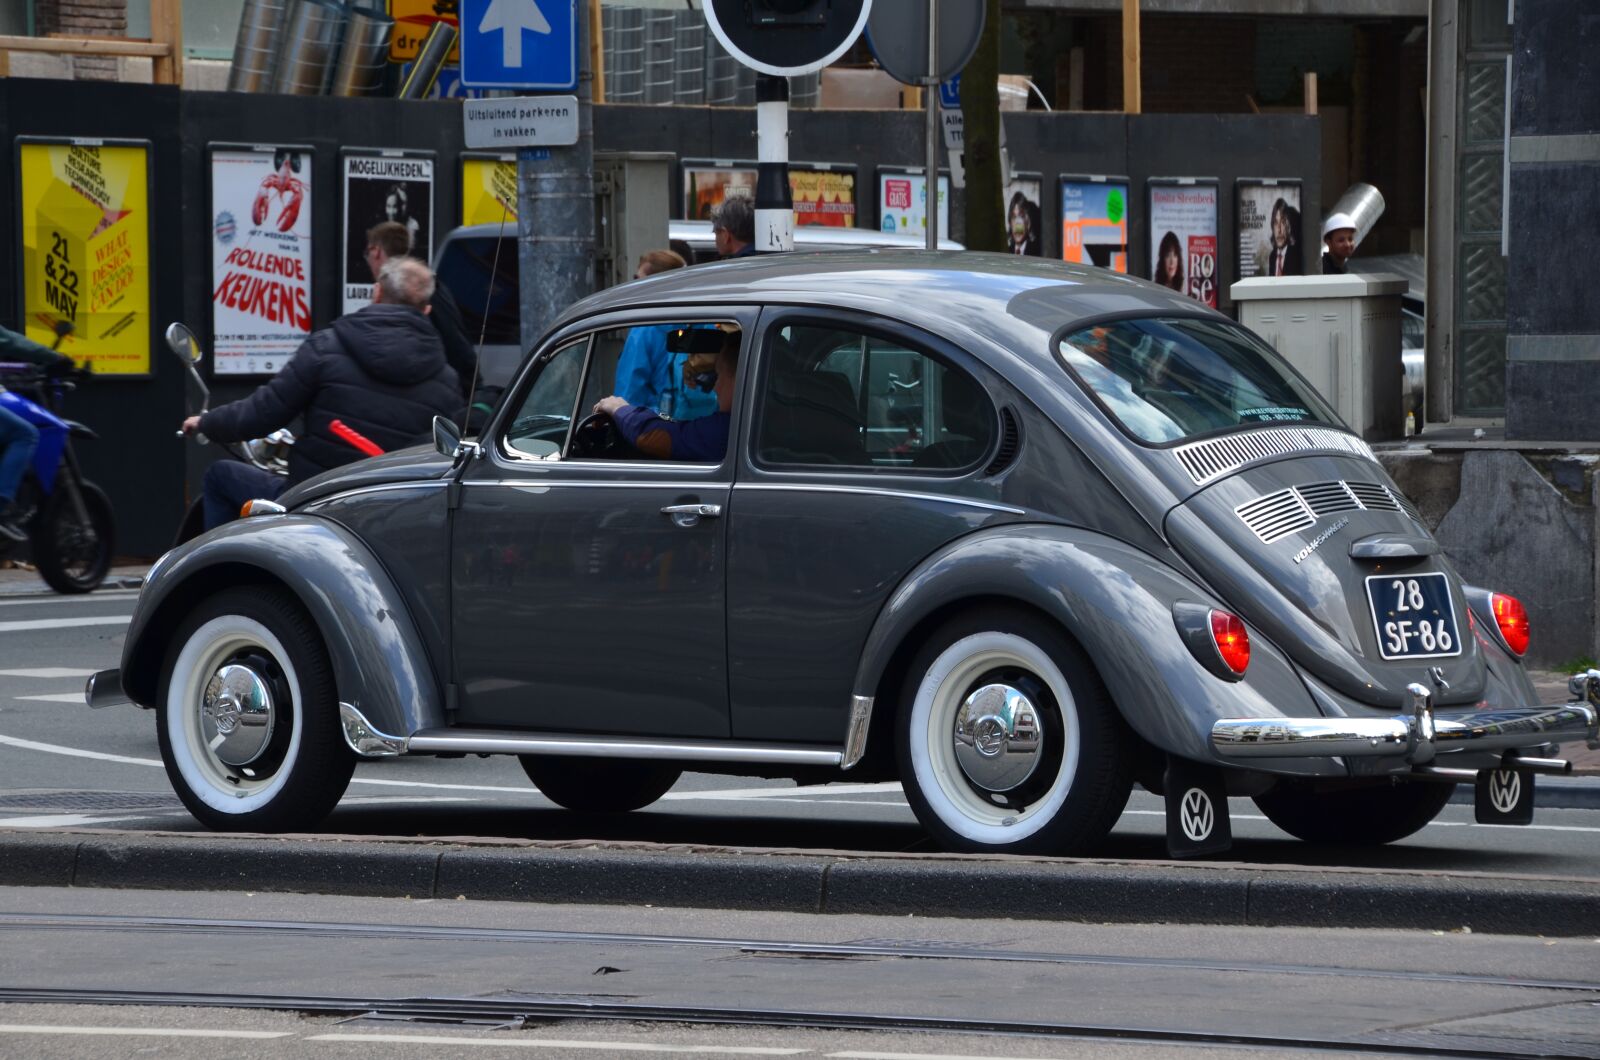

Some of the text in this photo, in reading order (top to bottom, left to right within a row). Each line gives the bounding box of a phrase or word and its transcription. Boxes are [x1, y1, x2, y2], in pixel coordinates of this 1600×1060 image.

[468, 106, 569, 121] Uitsluitend parkeren
[945, 115, 963, 126] Alle
[493, 126, 537, 138] in vakken
[64, 163, 111, 205] TECHNOLOGY
[67, 154, 106, 189] RESEARCH
[889, 191, 907, 207] GRATIS
[52, 231, 70, 263] 21
[95, 230, 128, 263] WHAT
[45, 253, 79, 297] & 22
[93, 246, 132, 286] DESIGN
[225, 247, 305, 281] ROLLENDE
[45, 279, 78, 322] MAY
[211, 271, 312, 332] KEUKENS
[1392, 579, 1424, 612] 28
[1385, 620, 1451, 653] SF-86
